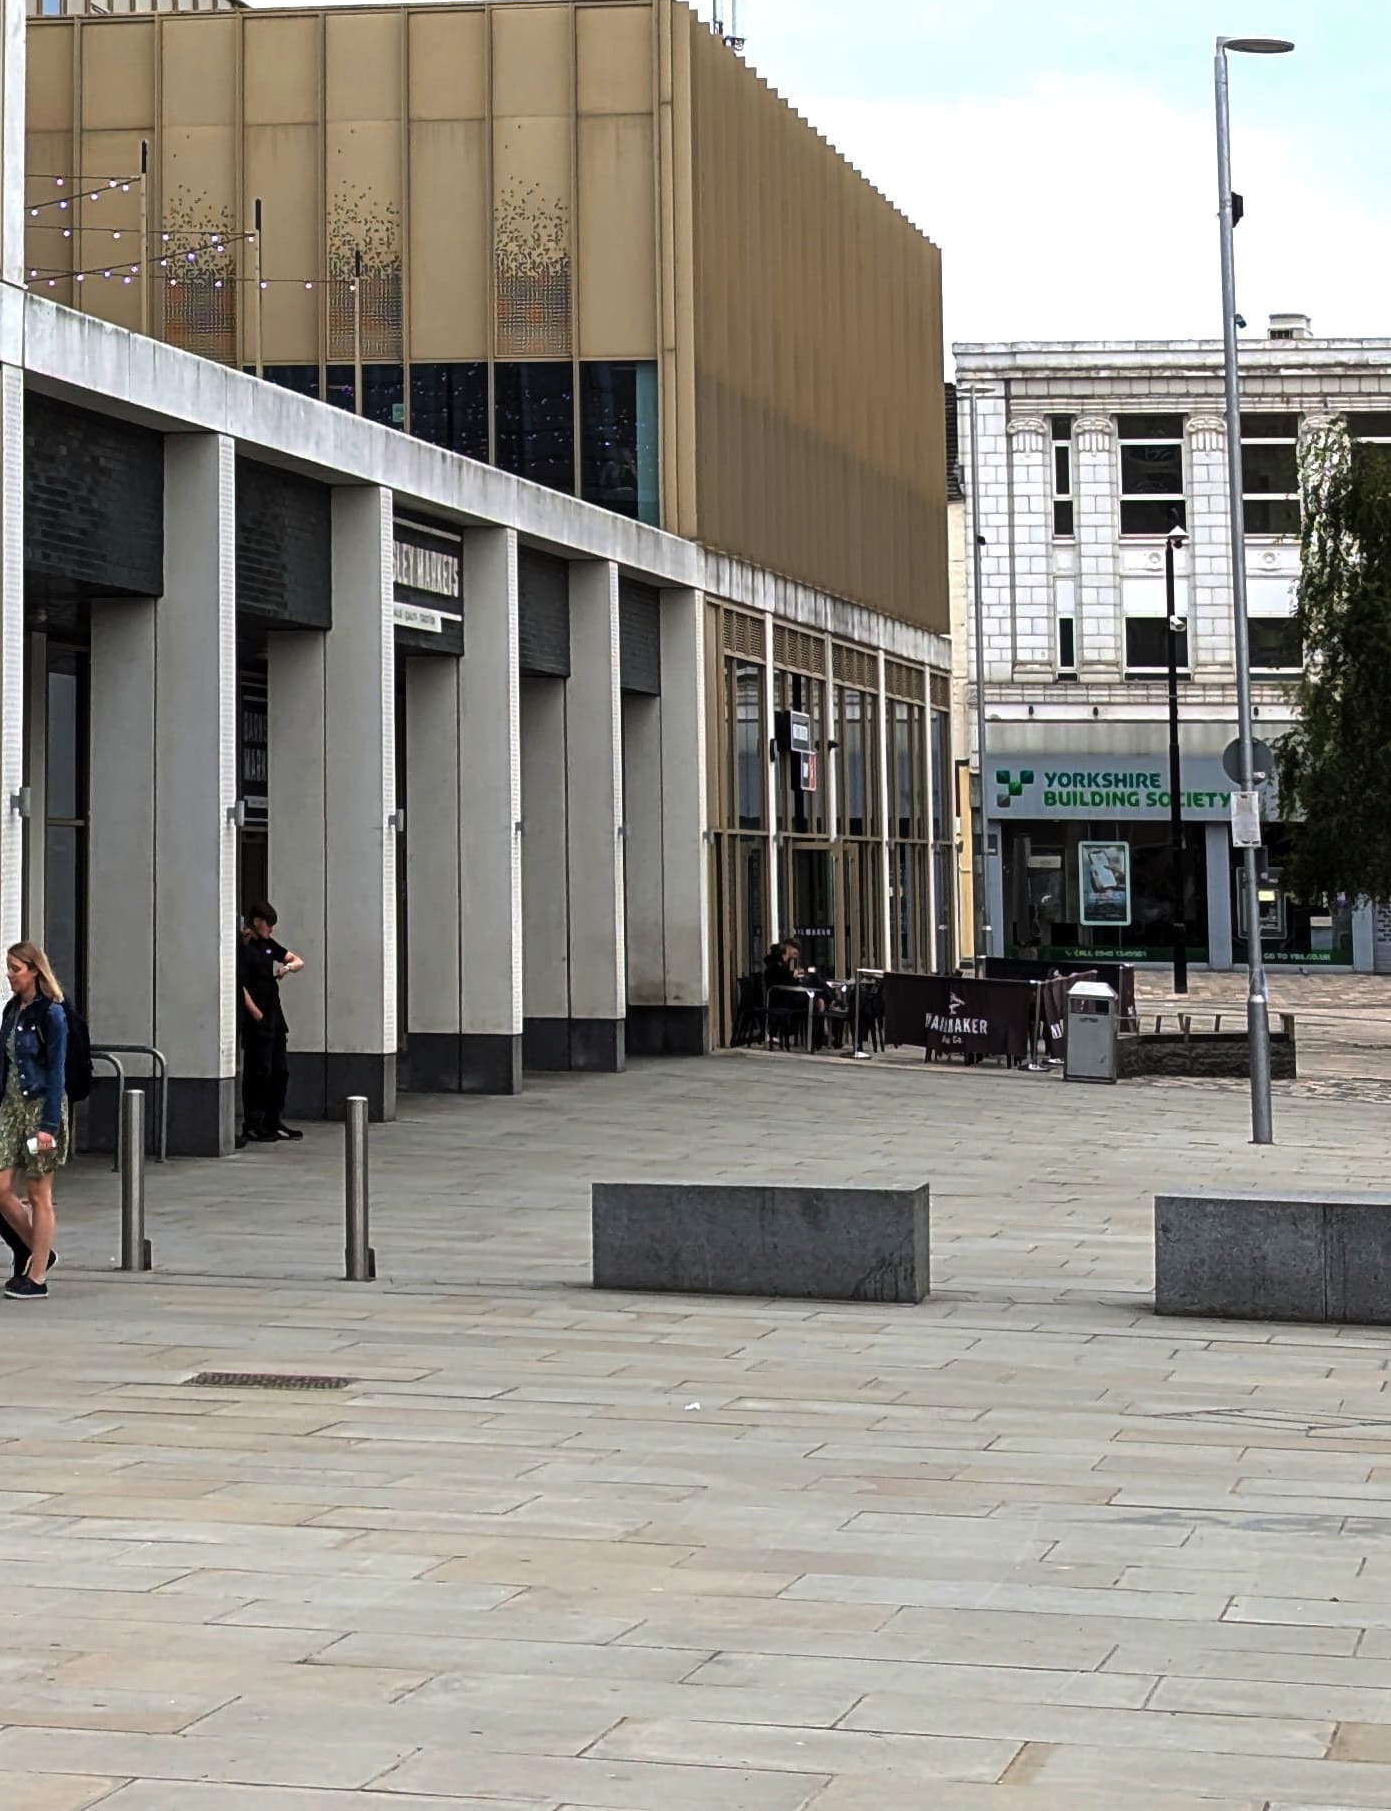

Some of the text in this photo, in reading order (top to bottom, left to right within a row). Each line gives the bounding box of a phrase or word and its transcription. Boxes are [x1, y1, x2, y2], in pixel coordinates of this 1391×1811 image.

[417, 548, 459, 598] MARKETS
[1043, 771, 1161, 789] YORKSHIRE
[1043, 791, 1140, 808] BUILDING
